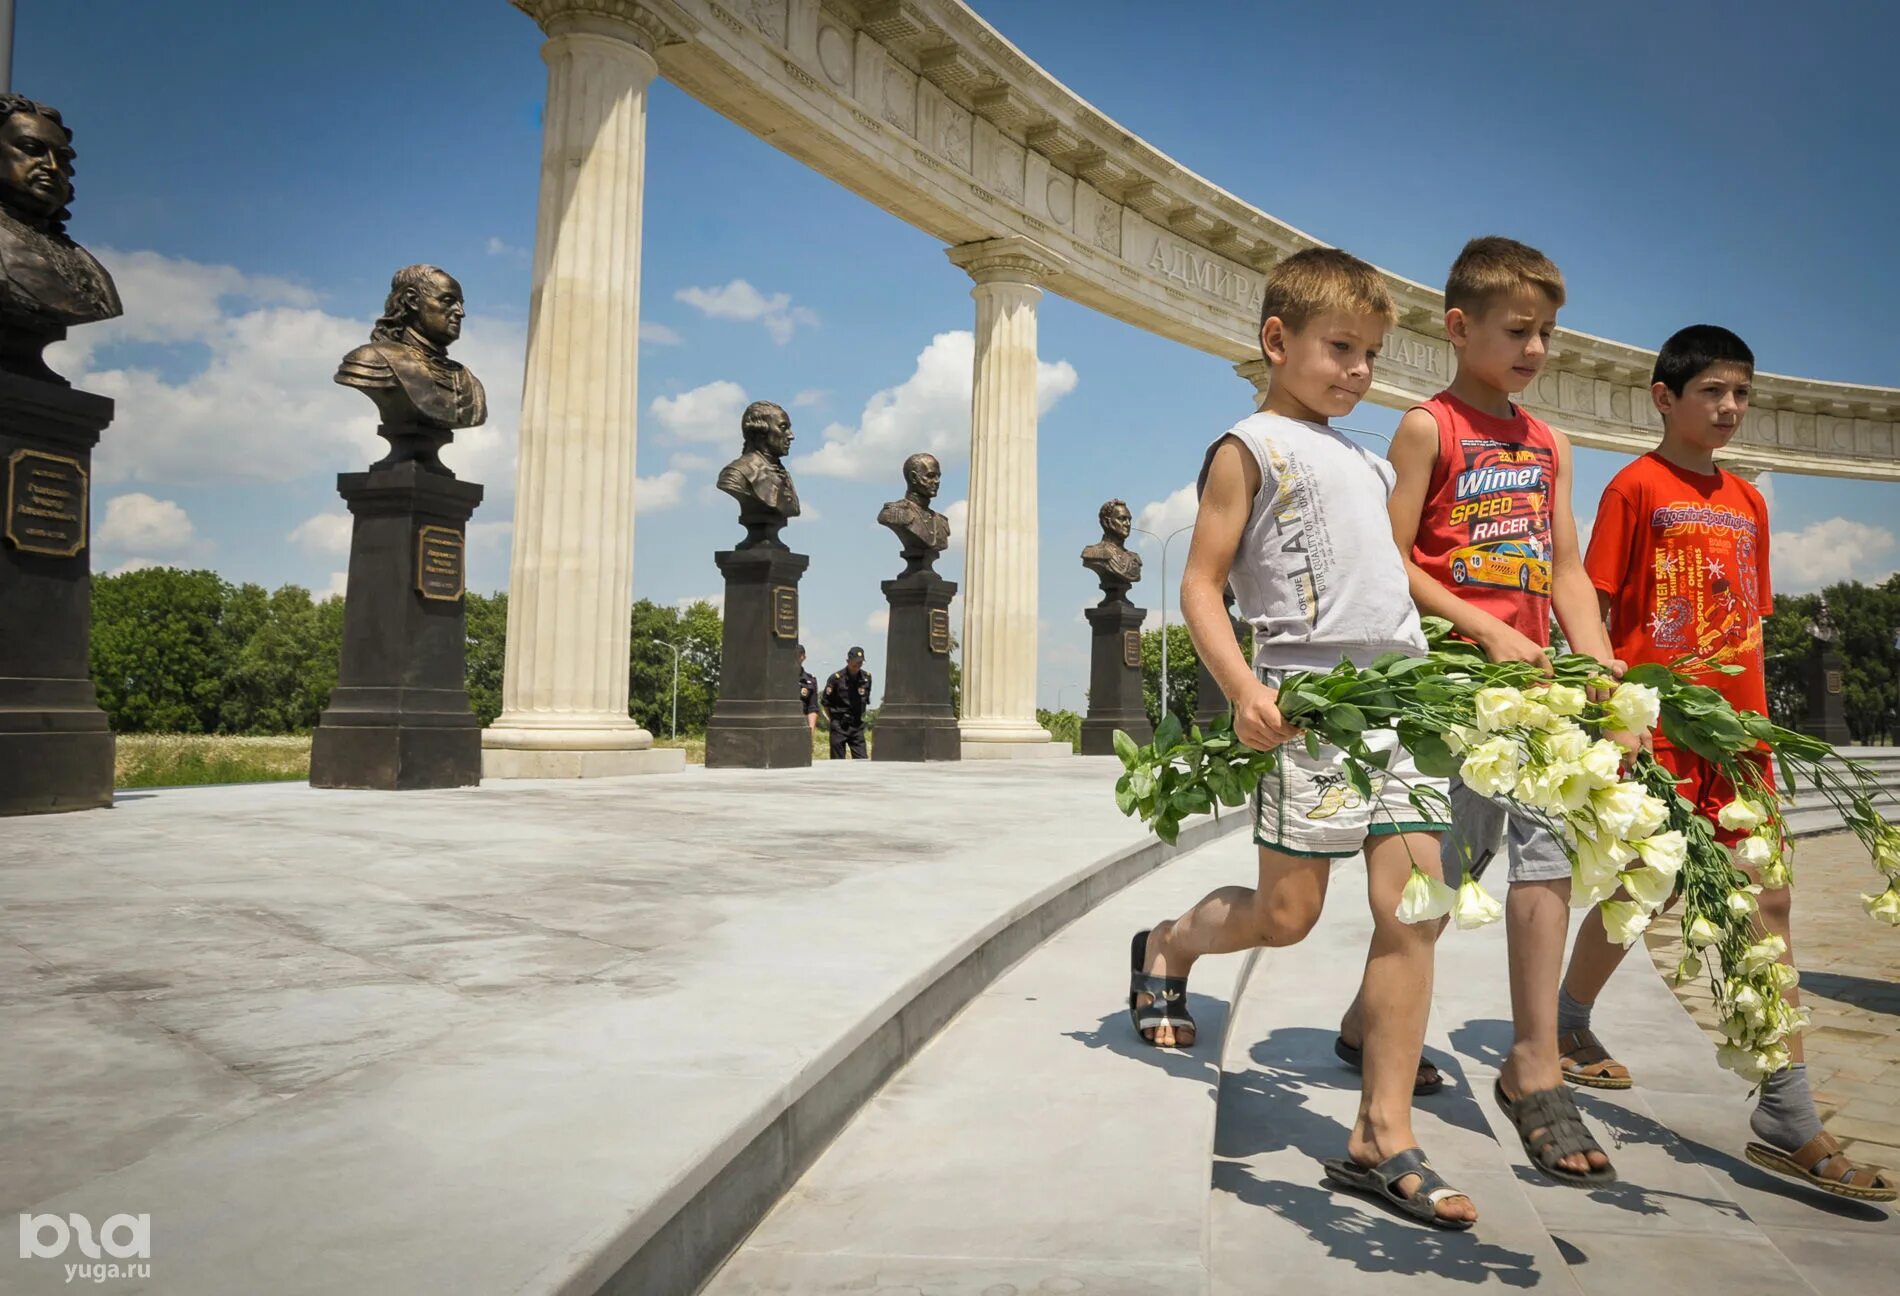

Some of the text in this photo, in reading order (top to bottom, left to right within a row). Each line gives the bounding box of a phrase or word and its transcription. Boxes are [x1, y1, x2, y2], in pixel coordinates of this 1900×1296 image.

[1457, 465, 1541, 498] Winner
[1449, 497, 1513, 527] SPEED
[1303, 519, 1314, 532] OF
[1472, 518, 1529, 541] RACER
[1307, 533, 1322, 571] QUALITY
[1471, 556, 1480, 566] 18
[1316, 573, 1327, 592] OUR
[1694, 547, 1704, 622] SPORT PLAYERS
